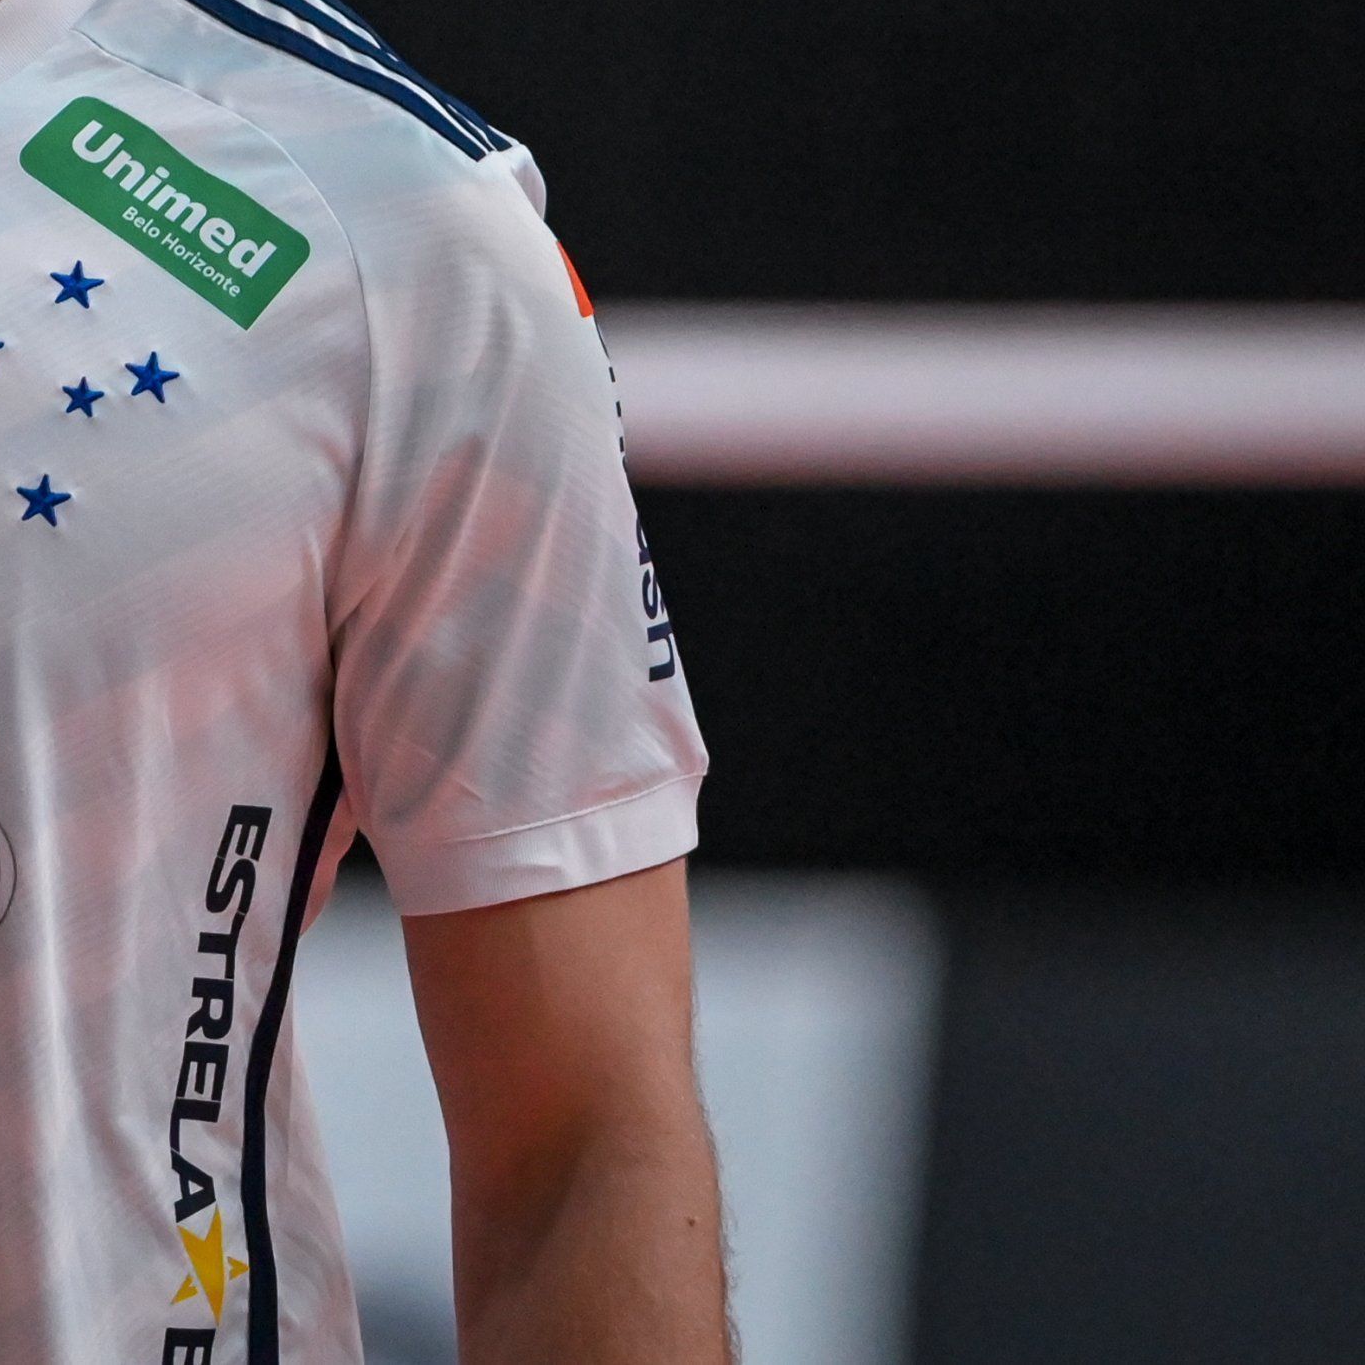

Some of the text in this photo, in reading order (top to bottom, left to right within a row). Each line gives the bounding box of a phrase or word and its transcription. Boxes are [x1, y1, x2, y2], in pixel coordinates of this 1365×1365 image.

[72, 120, 277, 278] Unimed
[122, 207, 241, 298] Belo Horizonte
[170, 804, 273, 1223] ESTRELA
